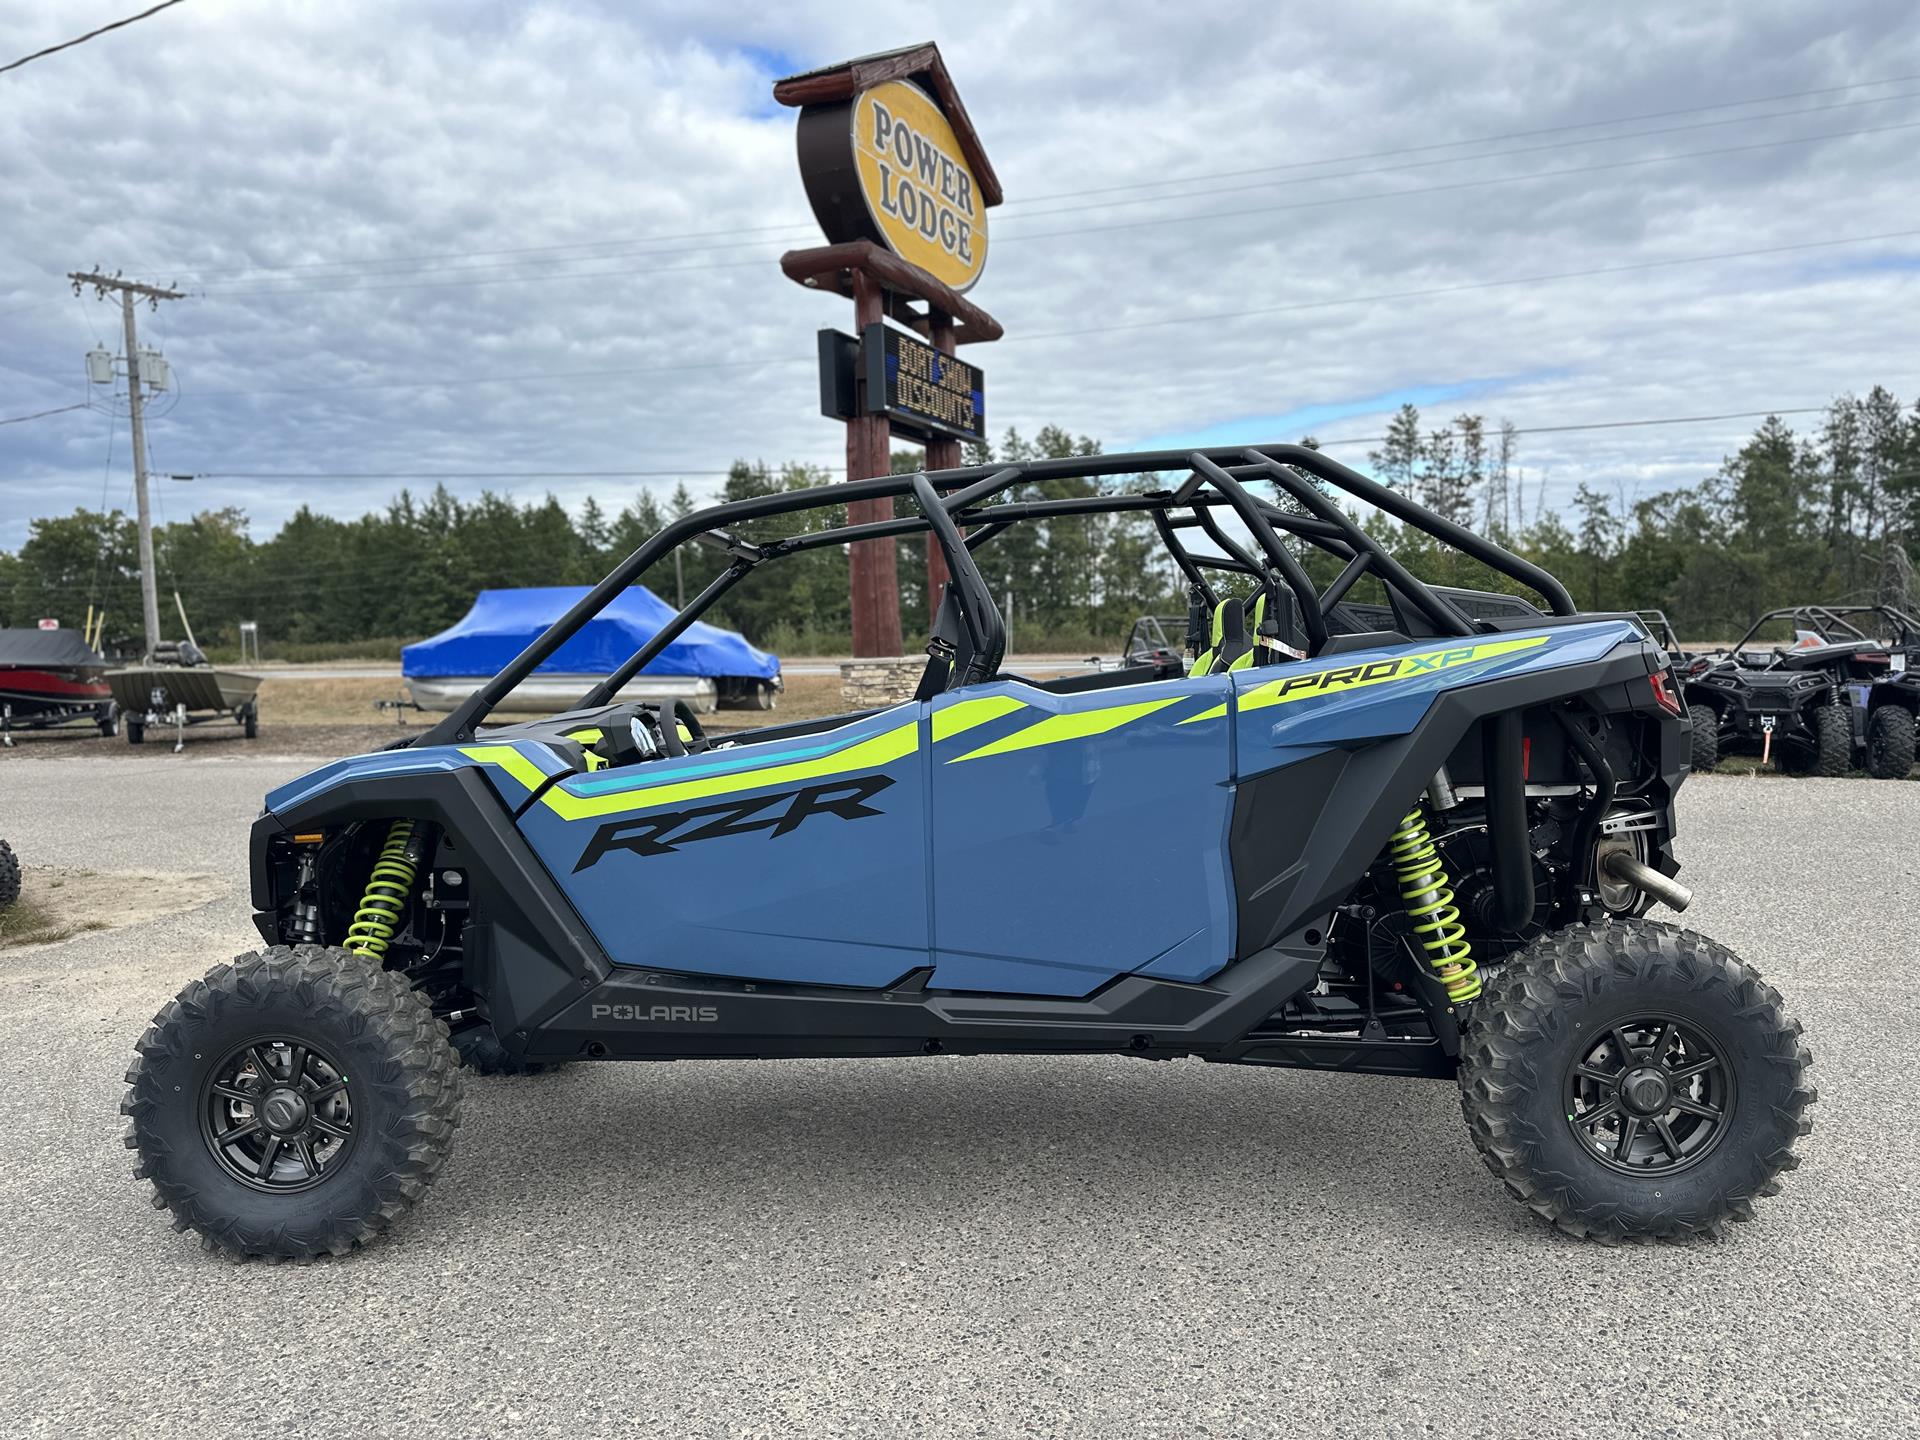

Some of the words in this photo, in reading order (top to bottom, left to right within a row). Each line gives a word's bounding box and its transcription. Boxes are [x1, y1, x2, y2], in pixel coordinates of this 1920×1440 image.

[873, 101, 974, 217] POWER
[879, 163, 972, 264] LODGE
[897, 372, 975, 430] DISCOUNTS!
[938, 355, 972, 397] SHOW
[571, 774, 897, 875] RZR
[591, 1004, 719, 1022] POLARIS
